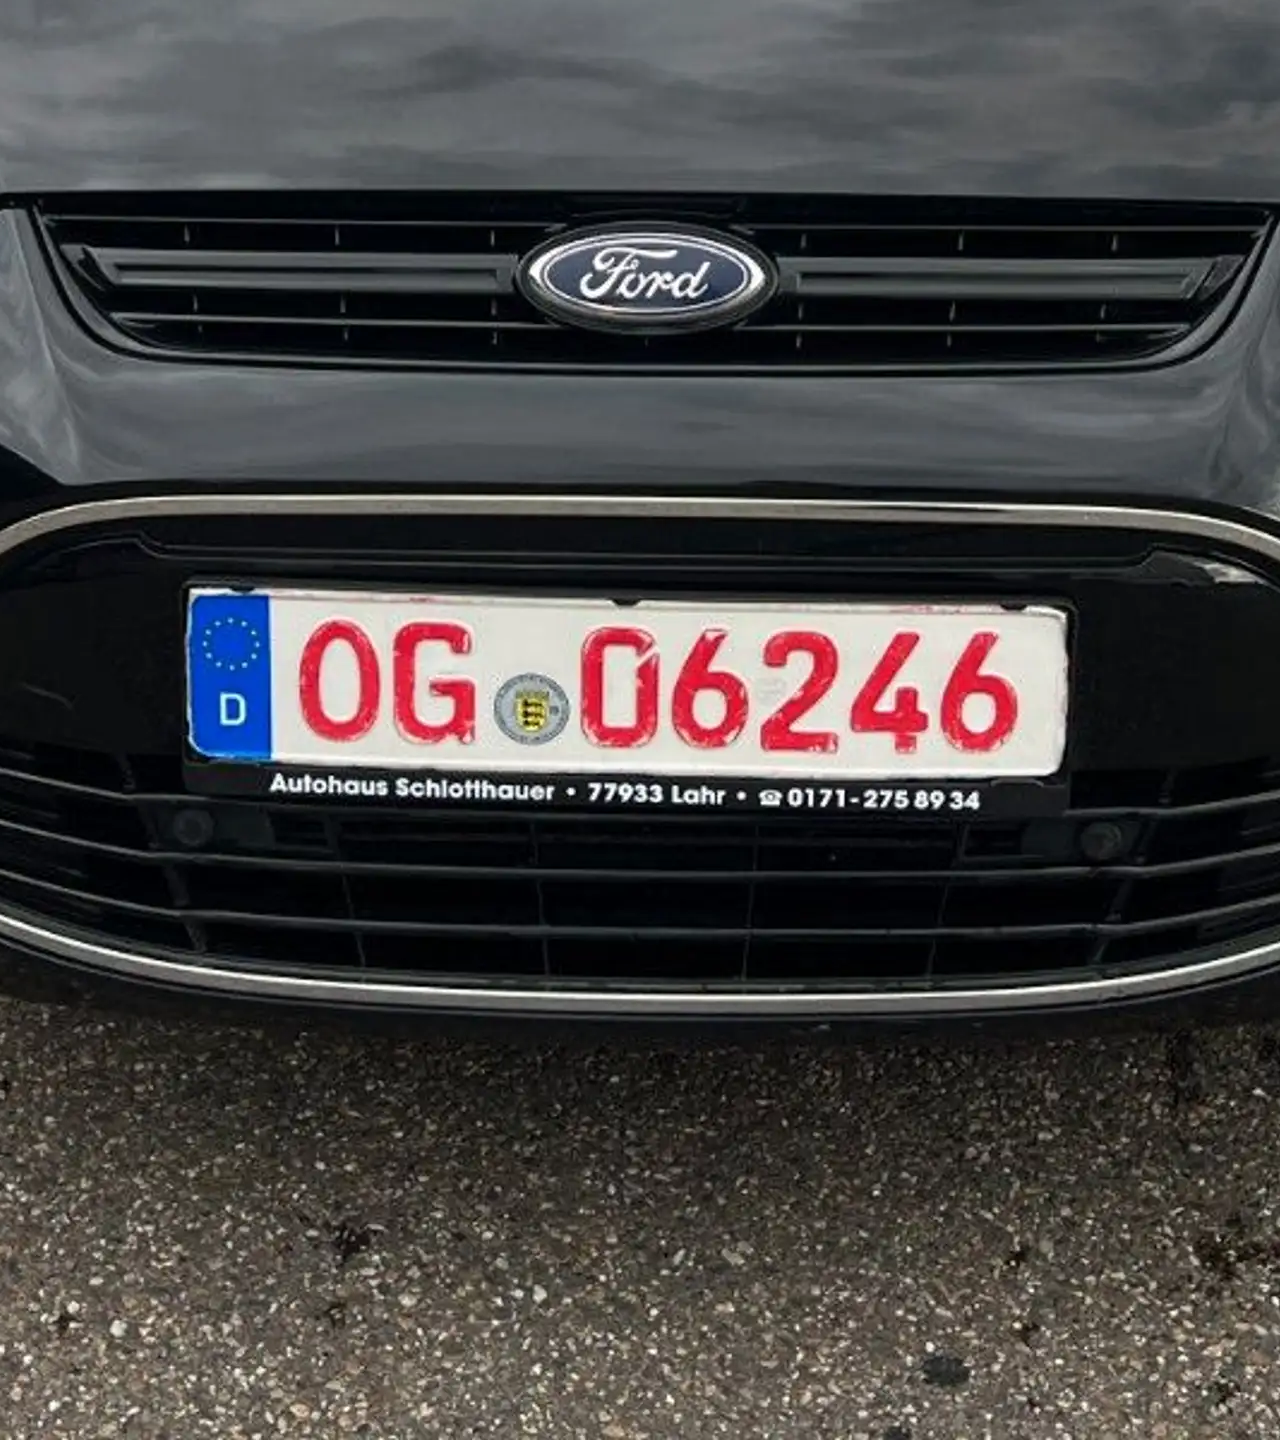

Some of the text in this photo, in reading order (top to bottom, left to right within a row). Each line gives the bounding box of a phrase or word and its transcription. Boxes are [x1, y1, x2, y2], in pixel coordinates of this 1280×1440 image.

[579, 246, 711, 299] Ford
[299, 619, 477, 744] OG
[580, 626, 1018, 753] 06246
[220, 693, 246, 726] D
[270, 772, 388, 797] Autohaus
[395, 776, 555, 801] Schlotthauer
[588, 782, 663, 803] 77933
[672, 785, 726, 805] Lahr
